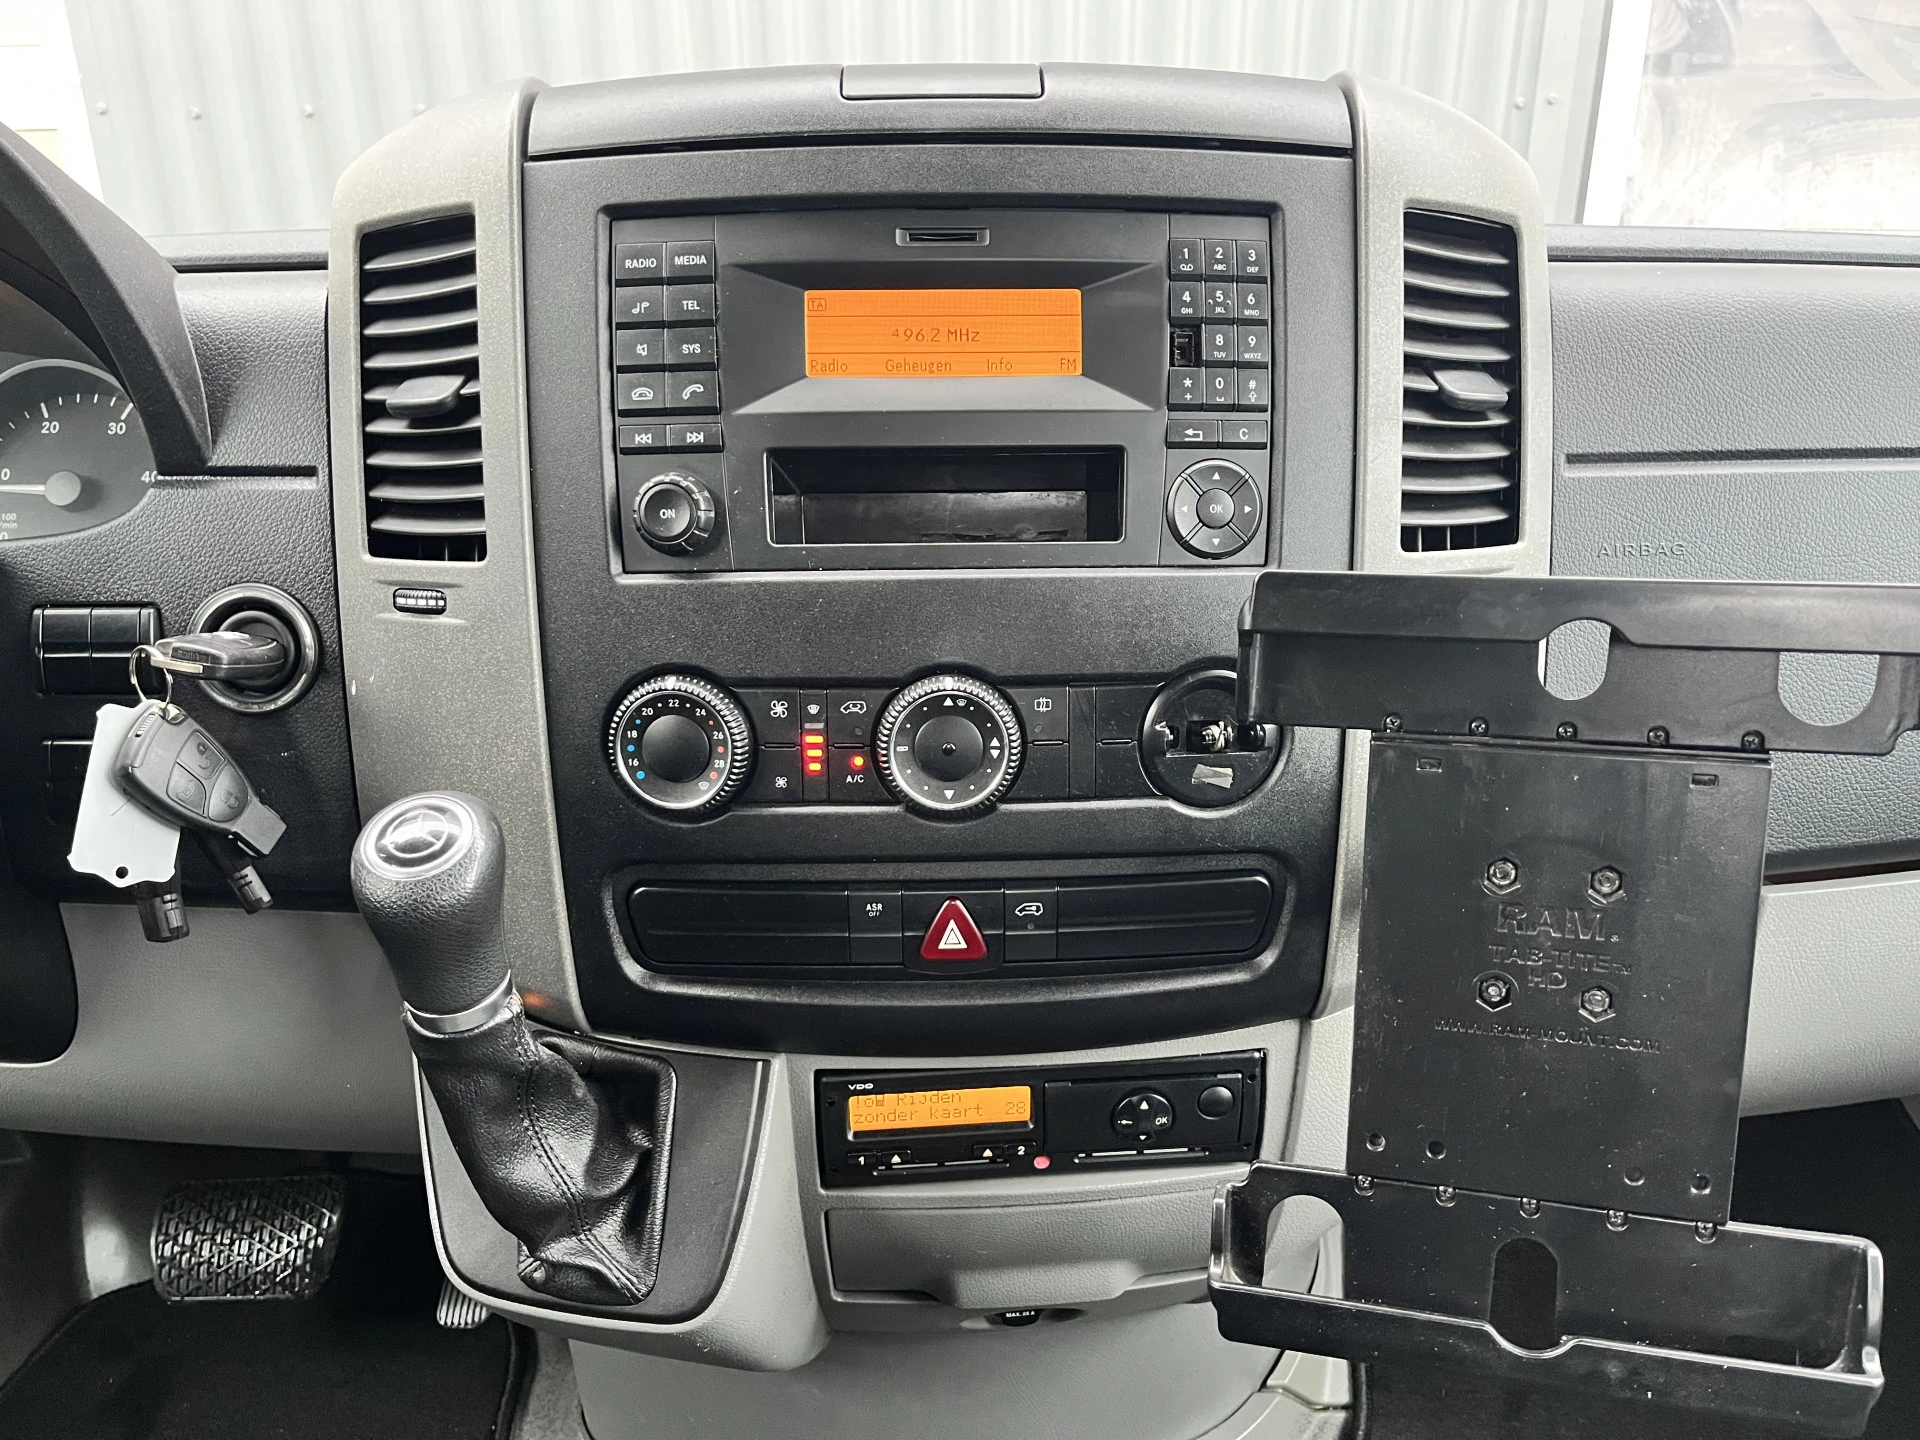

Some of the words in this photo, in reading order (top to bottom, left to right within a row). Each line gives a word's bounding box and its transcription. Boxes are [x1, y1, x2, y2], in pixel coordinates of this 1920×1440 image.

[1182, 247, 1189, 259] 1
[1215, 247, 1223, 259] 2
[1248, 249, 1256, 261] 3
[625, 258, 657, 268] RADIO
[674, 255, 707, 265] MEDIA
[1182, 290, 1191, 303] 4
[1215, 290, 1223, 302] 5
[1247, 293, 1255, 304] 6
[682, 301, 700, 310] TEL
[811, 300, 823, 310] TA
[947, 327, 980, 342] MHz
[1215, 334, 1224, 346] 8
[1248, 336, 1256, 347] 9
[682, 344, 701, 354] SYS
[811, 359, 848, 372] Radio
[885, 360, 952, 374] Geheugen
[987, 358, 1013, 371] Info
[1060, 359, 1077, 371] FM
[1215, 377, 1224, 389] 0
[41, 421, 60, 434] 20
[107, 422, 126, 435] 30
[1239, 427, 1249, 440] C
[660, 508, 676, 519] ON
[1209, 504, 1224, 514] OK
[1597, 541, 1686, 558] AIRBAG
[668, 699, 680, 707] 22
[641, 707, 654, 716] 20
[695, 708, 707, 717] 24
[627, 730, 638, 738] 18
[713, 731, 724, 740] 26
[628, 759, 639, 767] 16
[714, 759, 725, 768] 28
[846, 774, 865, 783] A/C
[866, 903, 883, 911] ASR
[1527, 968, 1568, 989] HD
[848, 1083, 874, 1091] VDO
[853, 1108, 918, 1124] zonder
[929, 1103, 983, 1120] kaart
[1005, 1101, 1027, 1115] 28
[1155, 1116, 1168, 1125] OK
[1017, 1145, 1026, 1155] 2
[857, 1155, 865, 1166] 1
